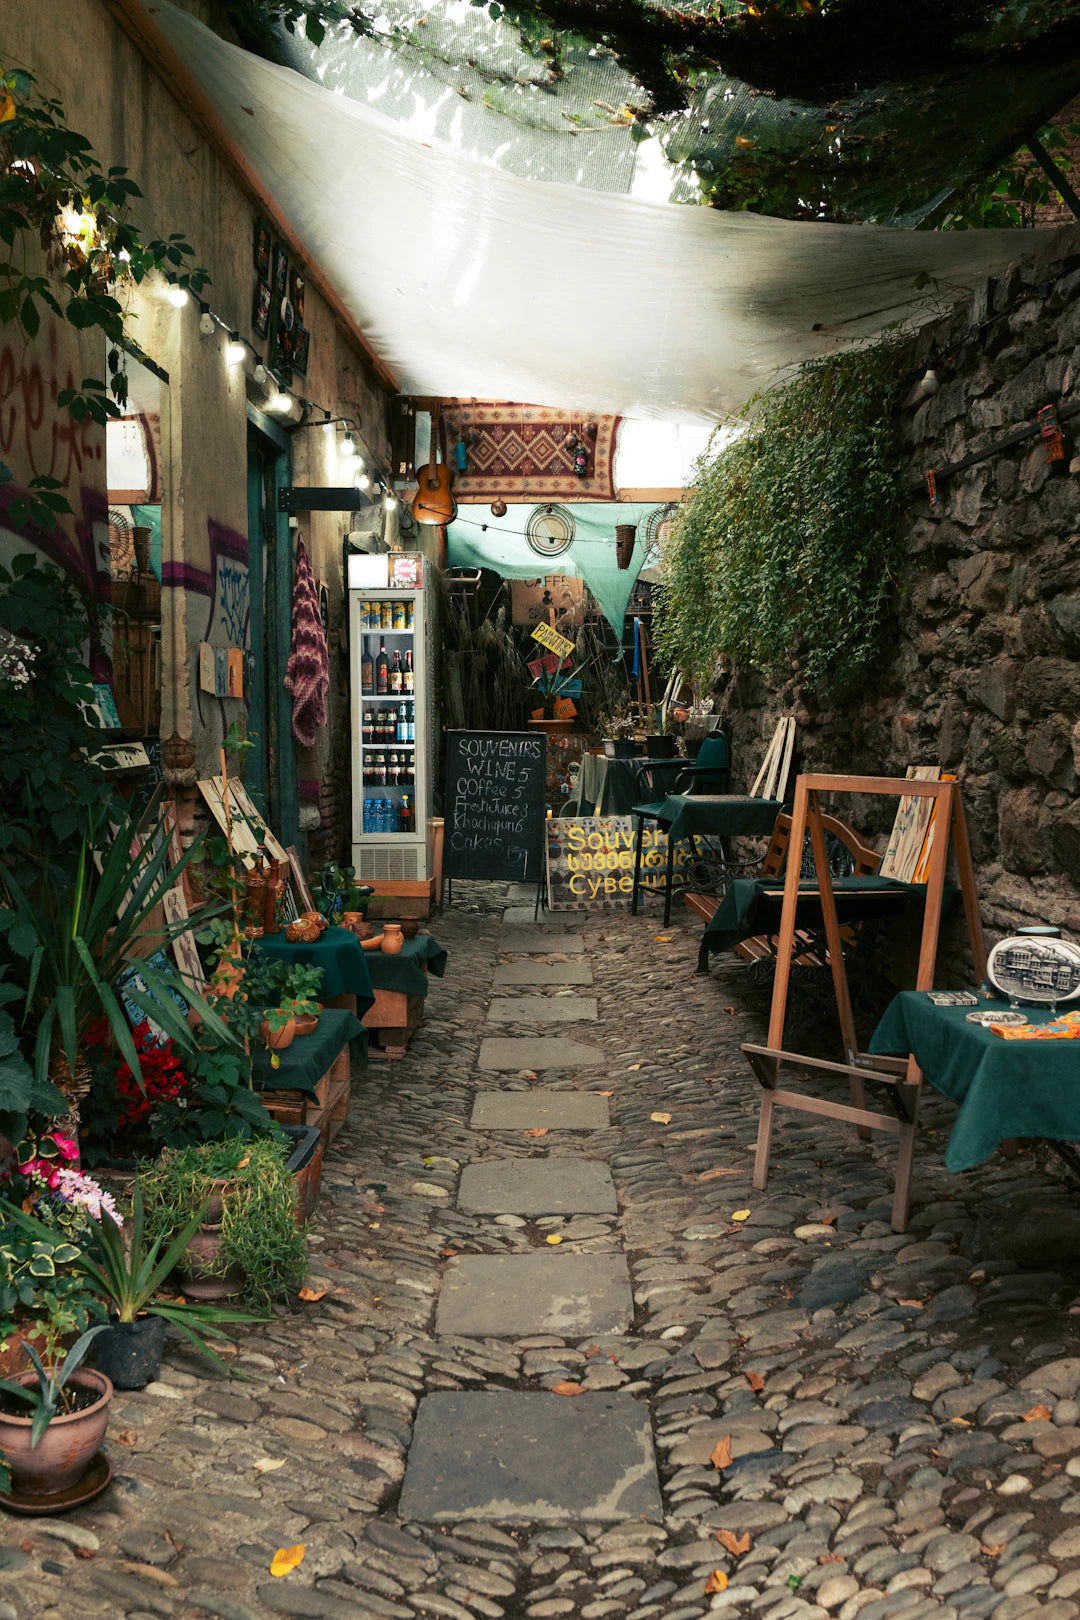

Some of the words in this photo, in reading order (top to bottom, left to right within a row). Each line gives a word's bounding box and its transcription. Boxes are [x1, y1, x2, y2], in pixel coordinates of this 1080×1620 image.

[542, 589, 554, 605] &
[458, 738, 541, 759] SOUVENIRS
[466, 757, 516, 781] WINE
[518, 767, 533, 783] 5
[511, 786, 527, 799] 5
[451, 831, 503, 851] Cakes
